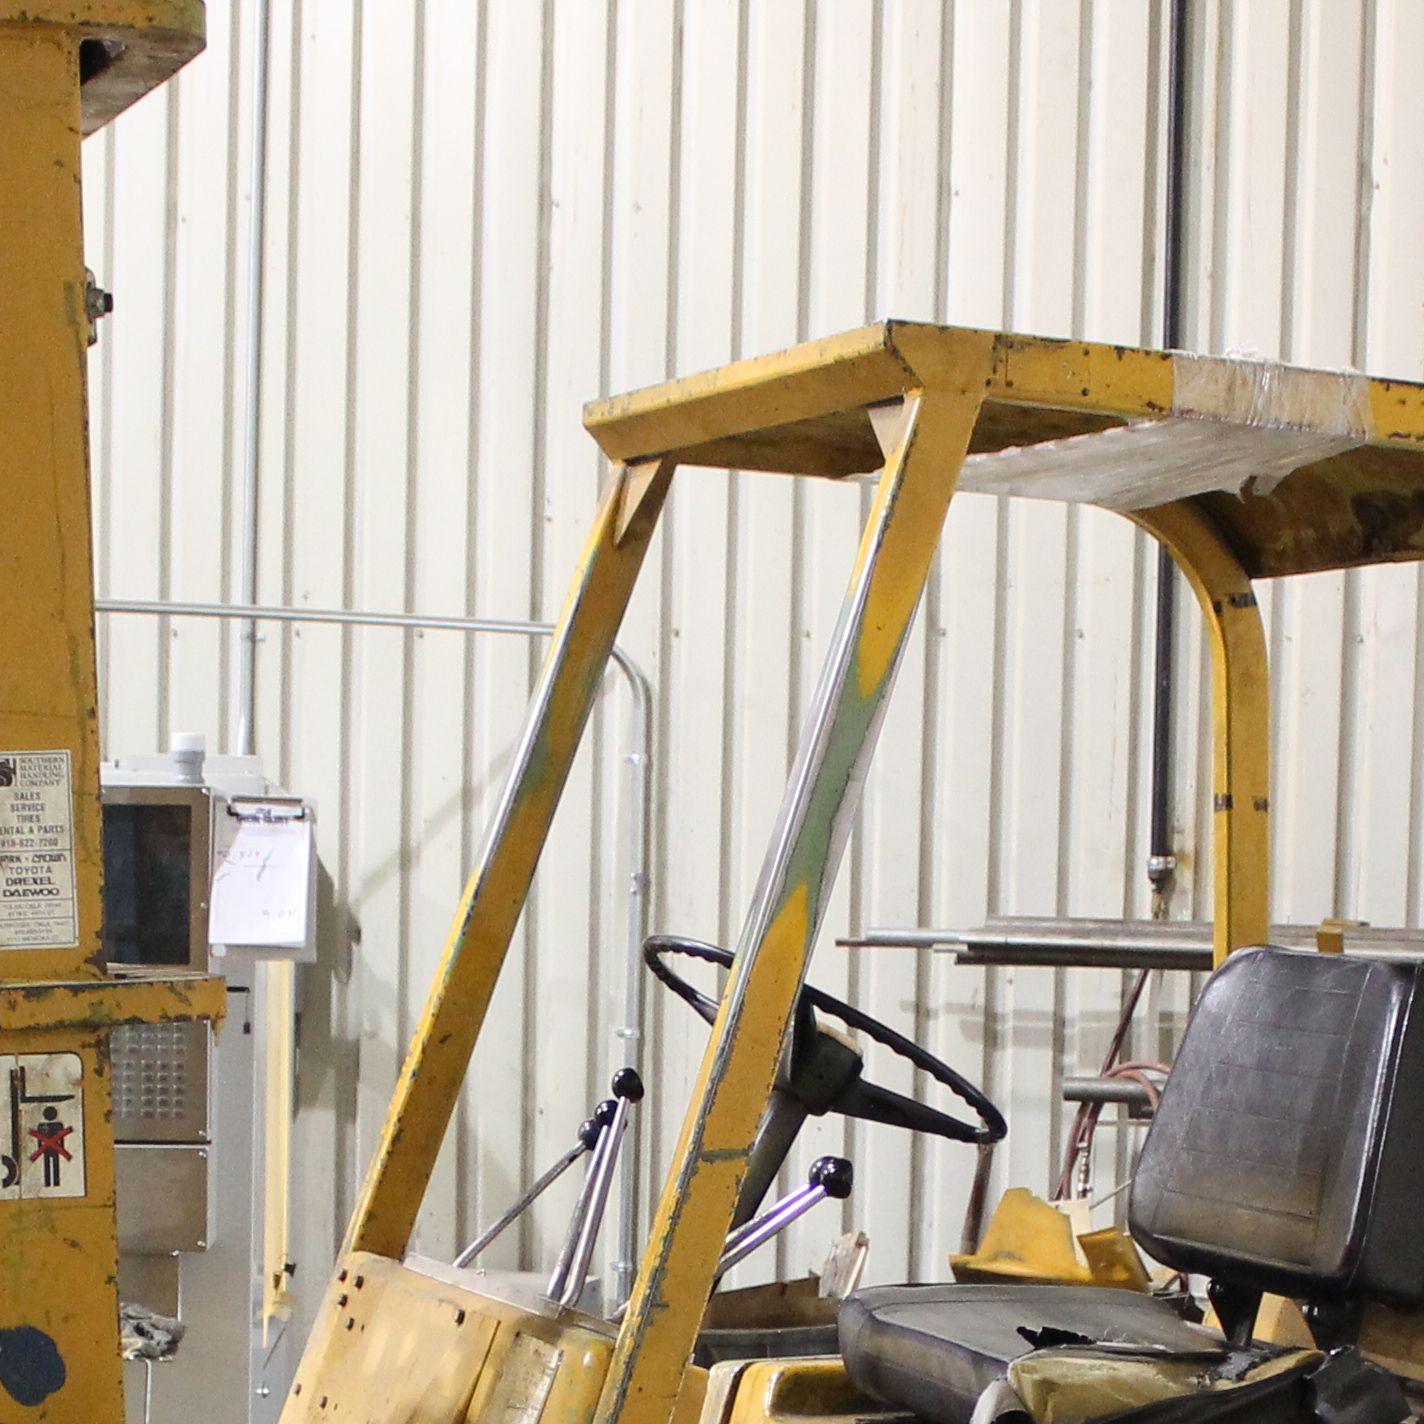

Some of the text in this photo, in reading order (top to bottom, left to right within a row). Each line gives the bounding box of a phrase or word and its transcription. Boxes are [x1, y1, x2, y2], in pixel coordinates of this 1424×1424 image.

[14, 791, 41, 800] SALES
[10, 803, 46, 812] SERVICE
[16, 814, 41, 823] TIRES
[37, 825, 64, 833] PARTS
[9, 866, 53, 875] TOYOTA
[5, 876, 57, 886] DREXEL
[2, 887, 60, 897] DAEWOO
